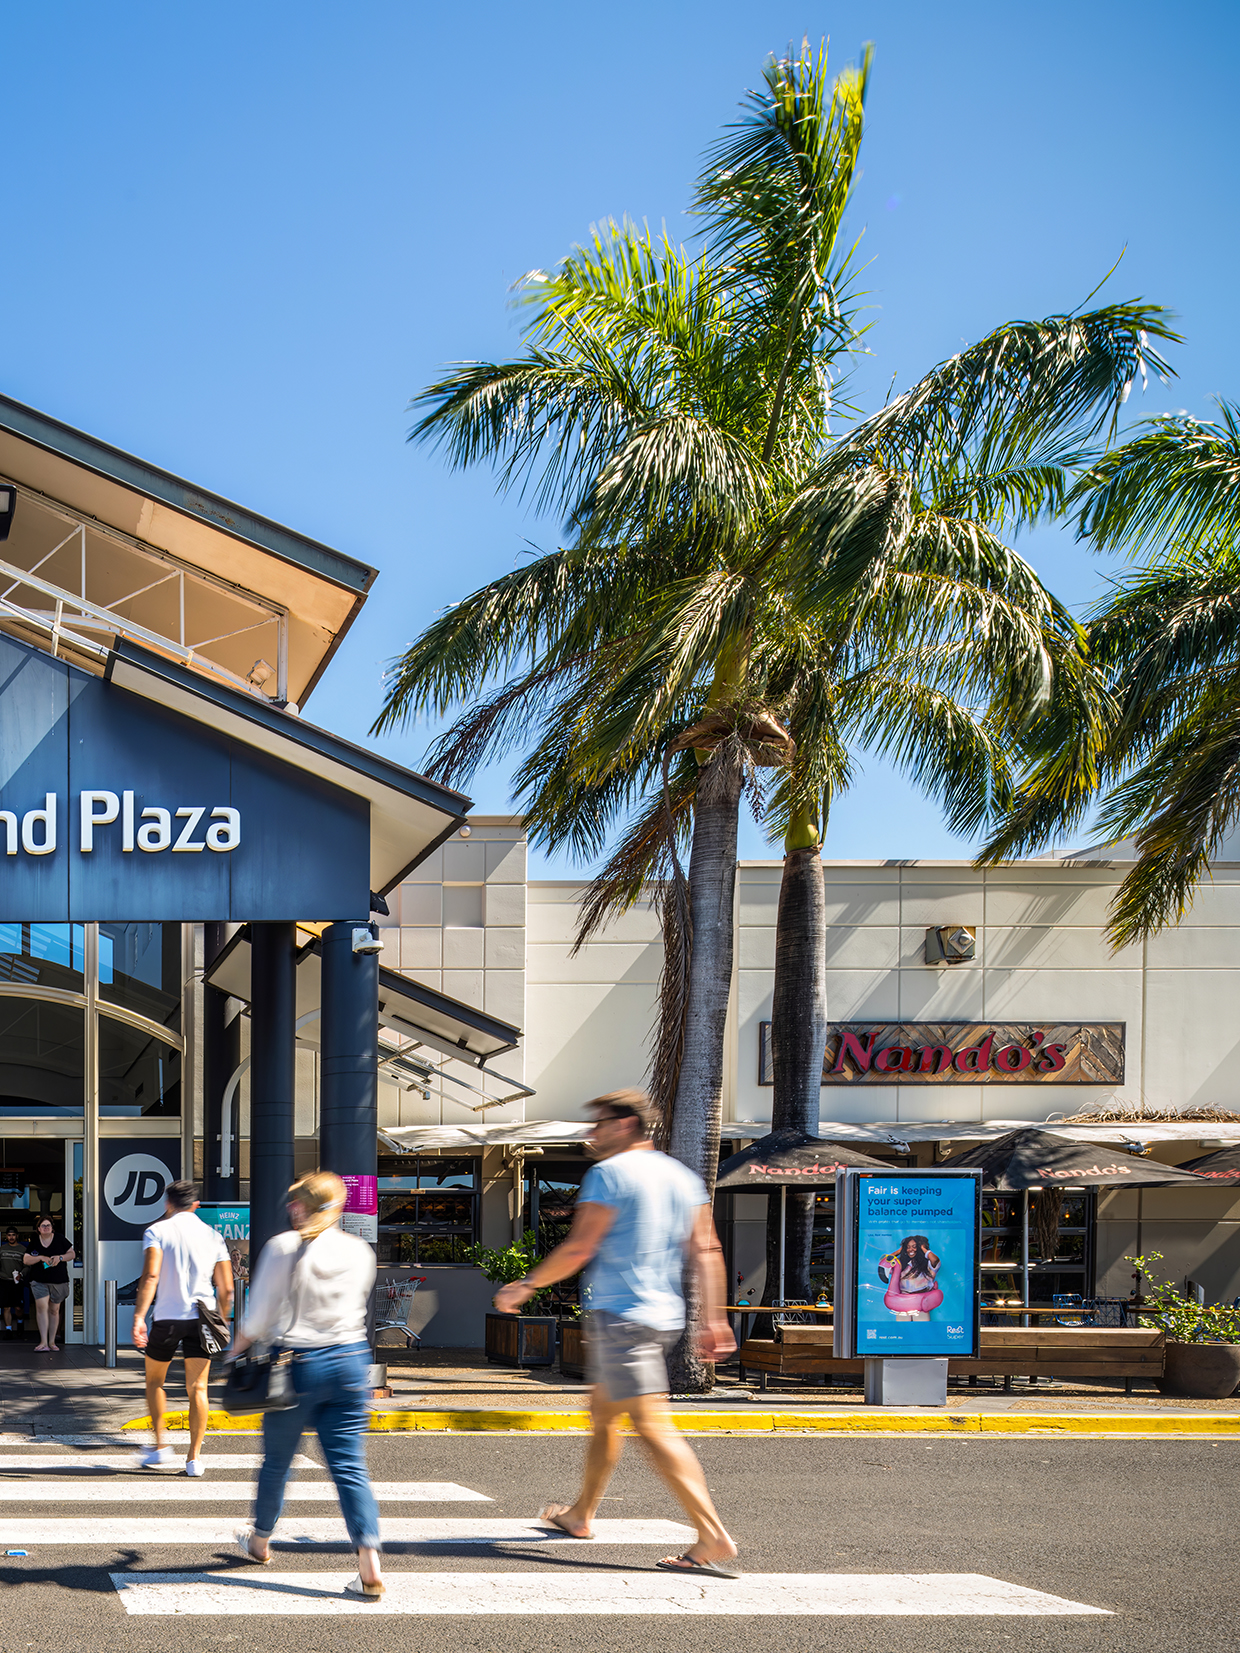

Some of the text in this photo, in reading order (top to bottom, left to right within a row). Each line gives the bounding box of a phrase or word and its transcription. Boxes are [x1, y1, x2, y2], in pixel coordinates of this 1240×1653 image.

[80, 789, 241, 853] Plaza
[831, 1030, 1068, 1075] Nando's
[748, 1161, 848, 1176] Nando's
[1035, 1163, 1132, 1178] Nando's
[113, 1170, 166, 1206] JD
[868, 1185, 942, 1197] Fair is keeping
[867, 1198, 922, 1207] your super
[219, 1211, 240, 1220] HEINZ
[868, 1207, 953, 1217] balance pumped
[210, 1224, 249, 1240] EAN
